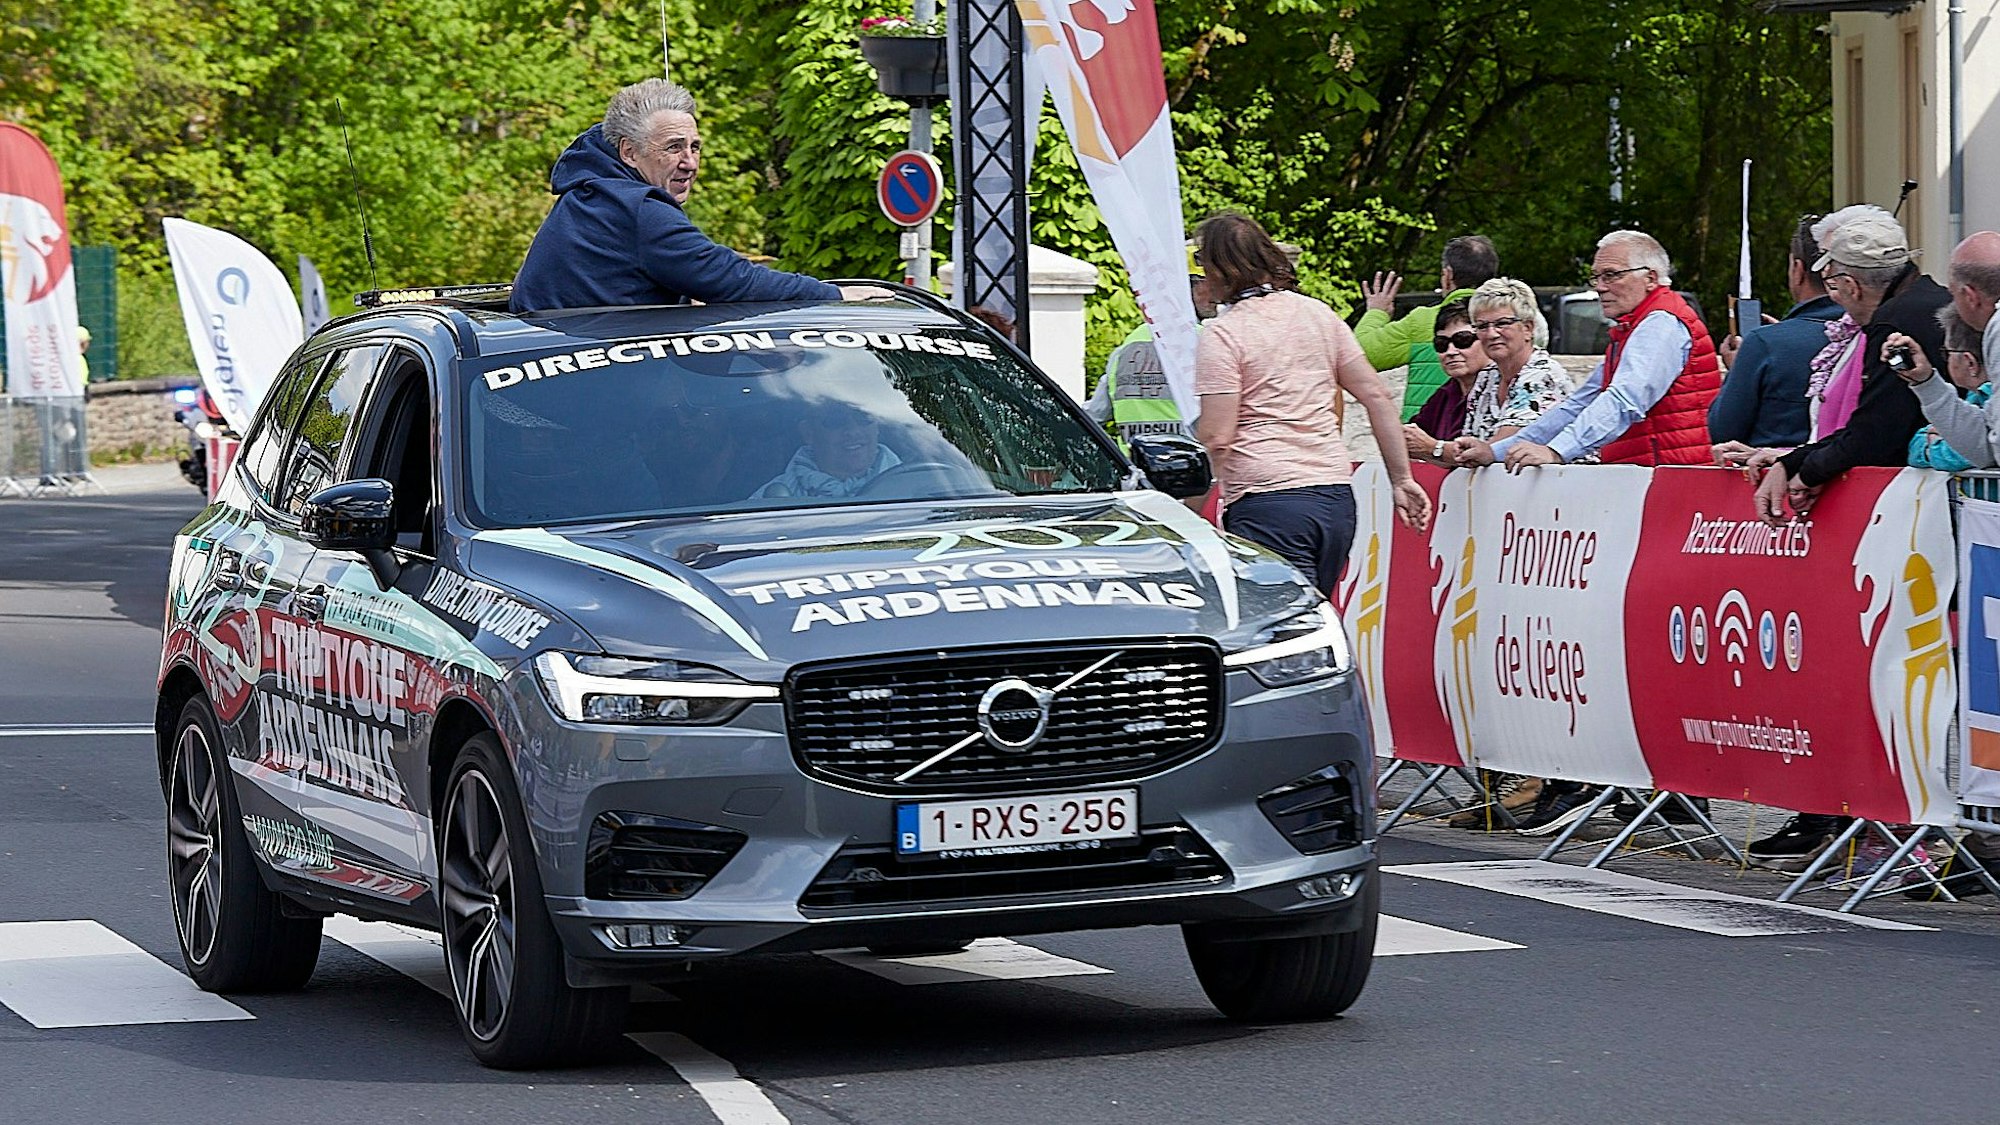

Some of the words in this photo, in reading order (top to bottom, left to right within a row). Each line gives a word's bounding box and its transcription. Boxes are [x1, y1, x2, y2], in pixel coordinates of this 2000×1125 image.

[483, 332, 775, 390] DIRECTION
[788, 329, 997, 361] COURSE
[1498, 507, 1597, 590] Province
[1681, 511, 1737, 554] Restez
[423, 566, 497, 625] DIRECTION
[479, 596, 551, 650] COURSE
[733, 558, 1129, 604] TRIPTYQUE
[790, 581, 1206, 633] ARDENNAIS
[271, 616, 407, 728] TRIPTYQUE
[1496, 614, 1522, 697] de
[1525, 616, 1589, 738] Liège
[989, 709, 1039, 721] VOLVO
[258, 690, 406, 804] ARDENNAIS
[901, 832, 918, 849] B
[933, 797, 1126, 844] 1-RXS-256
